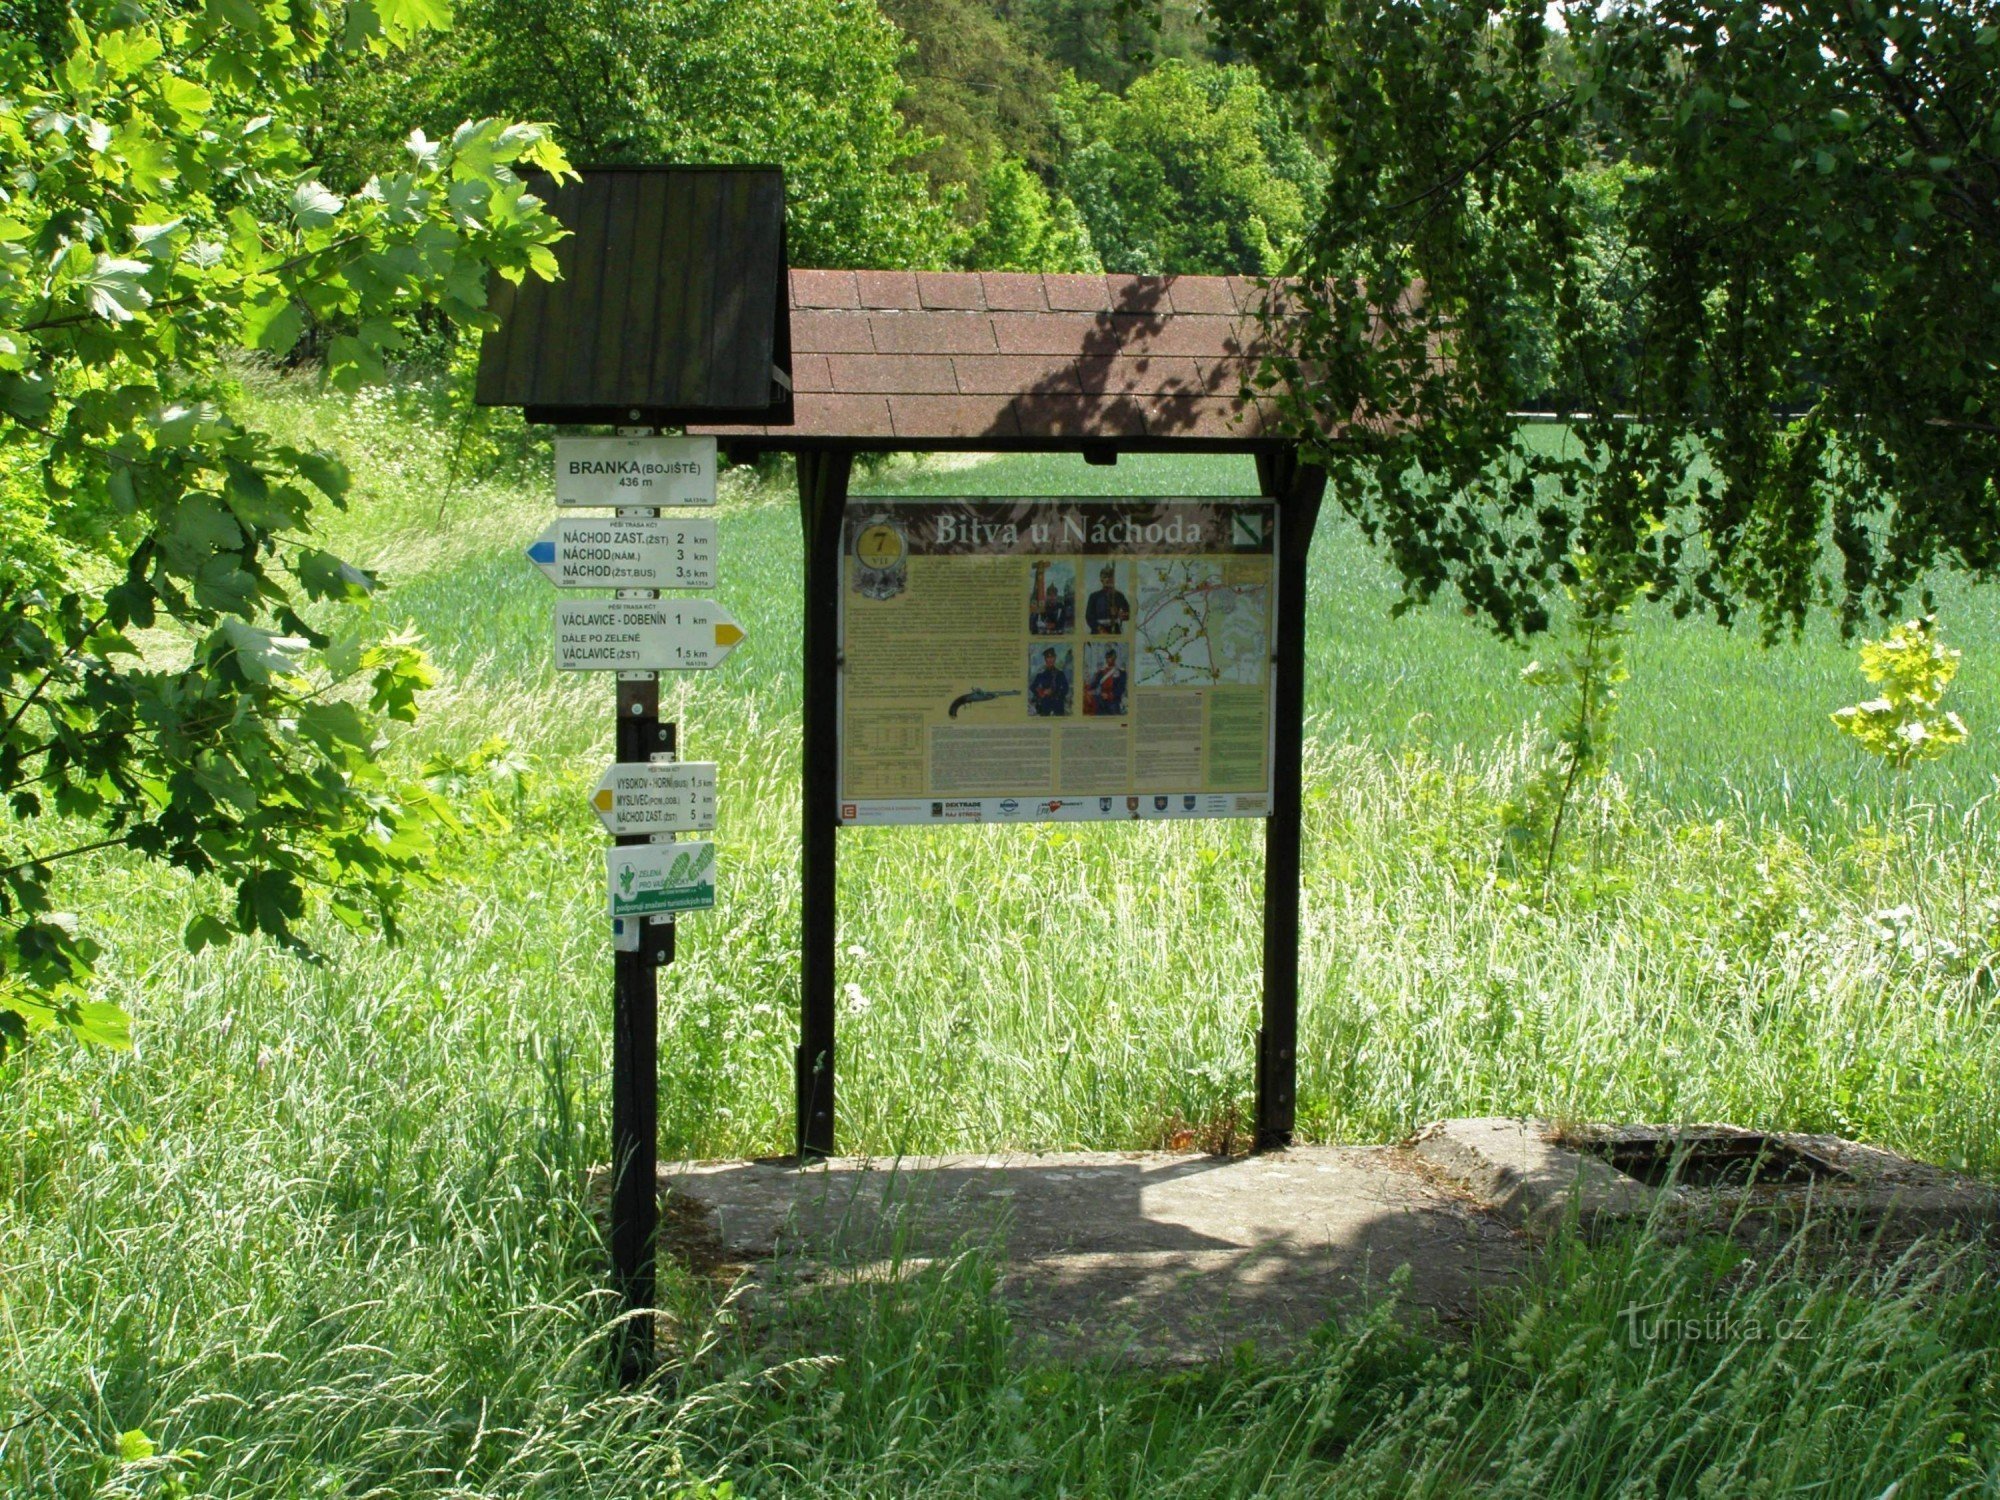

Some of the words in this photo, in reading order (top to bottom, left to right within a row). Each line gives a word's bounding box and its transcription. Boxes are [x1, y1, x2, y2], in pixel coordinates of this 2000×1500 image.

[619, 477, 639, 487] 436
[642, 479, 653, 487] m
[935, 514, 1019, 544] Bitva
[1031, 522, 1050, 544] u
[1062, 514, 1202, 544] Náchoda
[563, 530, 611, 544] NÁCHOD
[677, 533, 685, 544] 2
[694, 536, 708, 544] km
[873, 532, 887, 552] 7
[677, 549, 685, 561] 3
[694, 553, 708, 561] km
[694, 569, 708, 577] km
[562, 612, 616, 625] VÁCLAVICE
[623, 611, 667, 625] DOBENÍN
[675, 614, 682, 625] 1
[693, 617, 707, 625] km
[562, 632, 587, 643] DÁLE
[589, 634, 603, 643] PO
[604, 633, 641, 643] ZELENÉ
[693, 650, 708, 659] km
[617, 777, 647, 790] VYSOKOV
[703, 779, 713, 787] km
[690, 793, 696, 804] 2
[617, 810, 645, 823] NÁCHOD
[690, 809, 696, 820] 5
[639, 880, 652, 889] PRO
